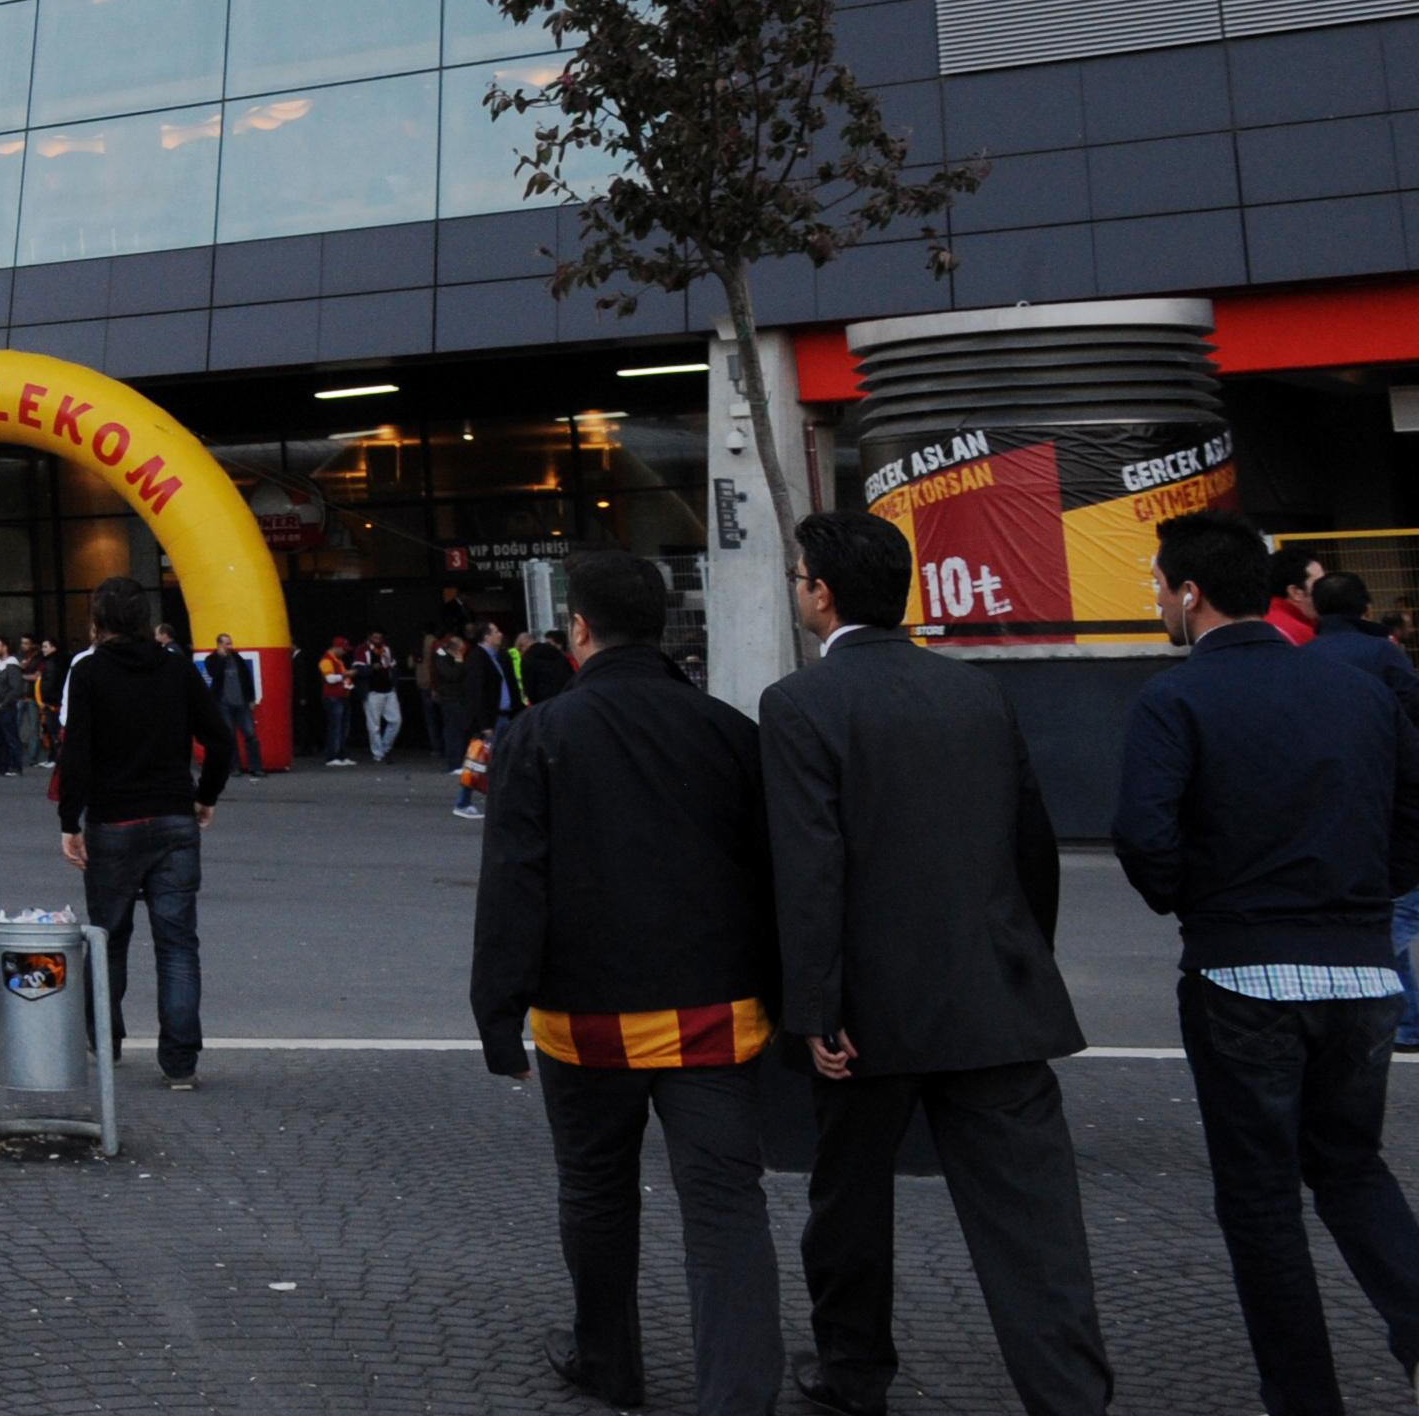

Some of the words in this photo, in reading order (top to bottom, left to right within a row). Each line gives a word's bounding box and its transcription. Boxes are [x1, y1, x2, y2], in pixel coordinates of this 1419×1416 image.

[911, 430, 991, 477] ASLAN
[912, 462, 996, 509] KORSAN
[451, 550, 461, 567] 3
